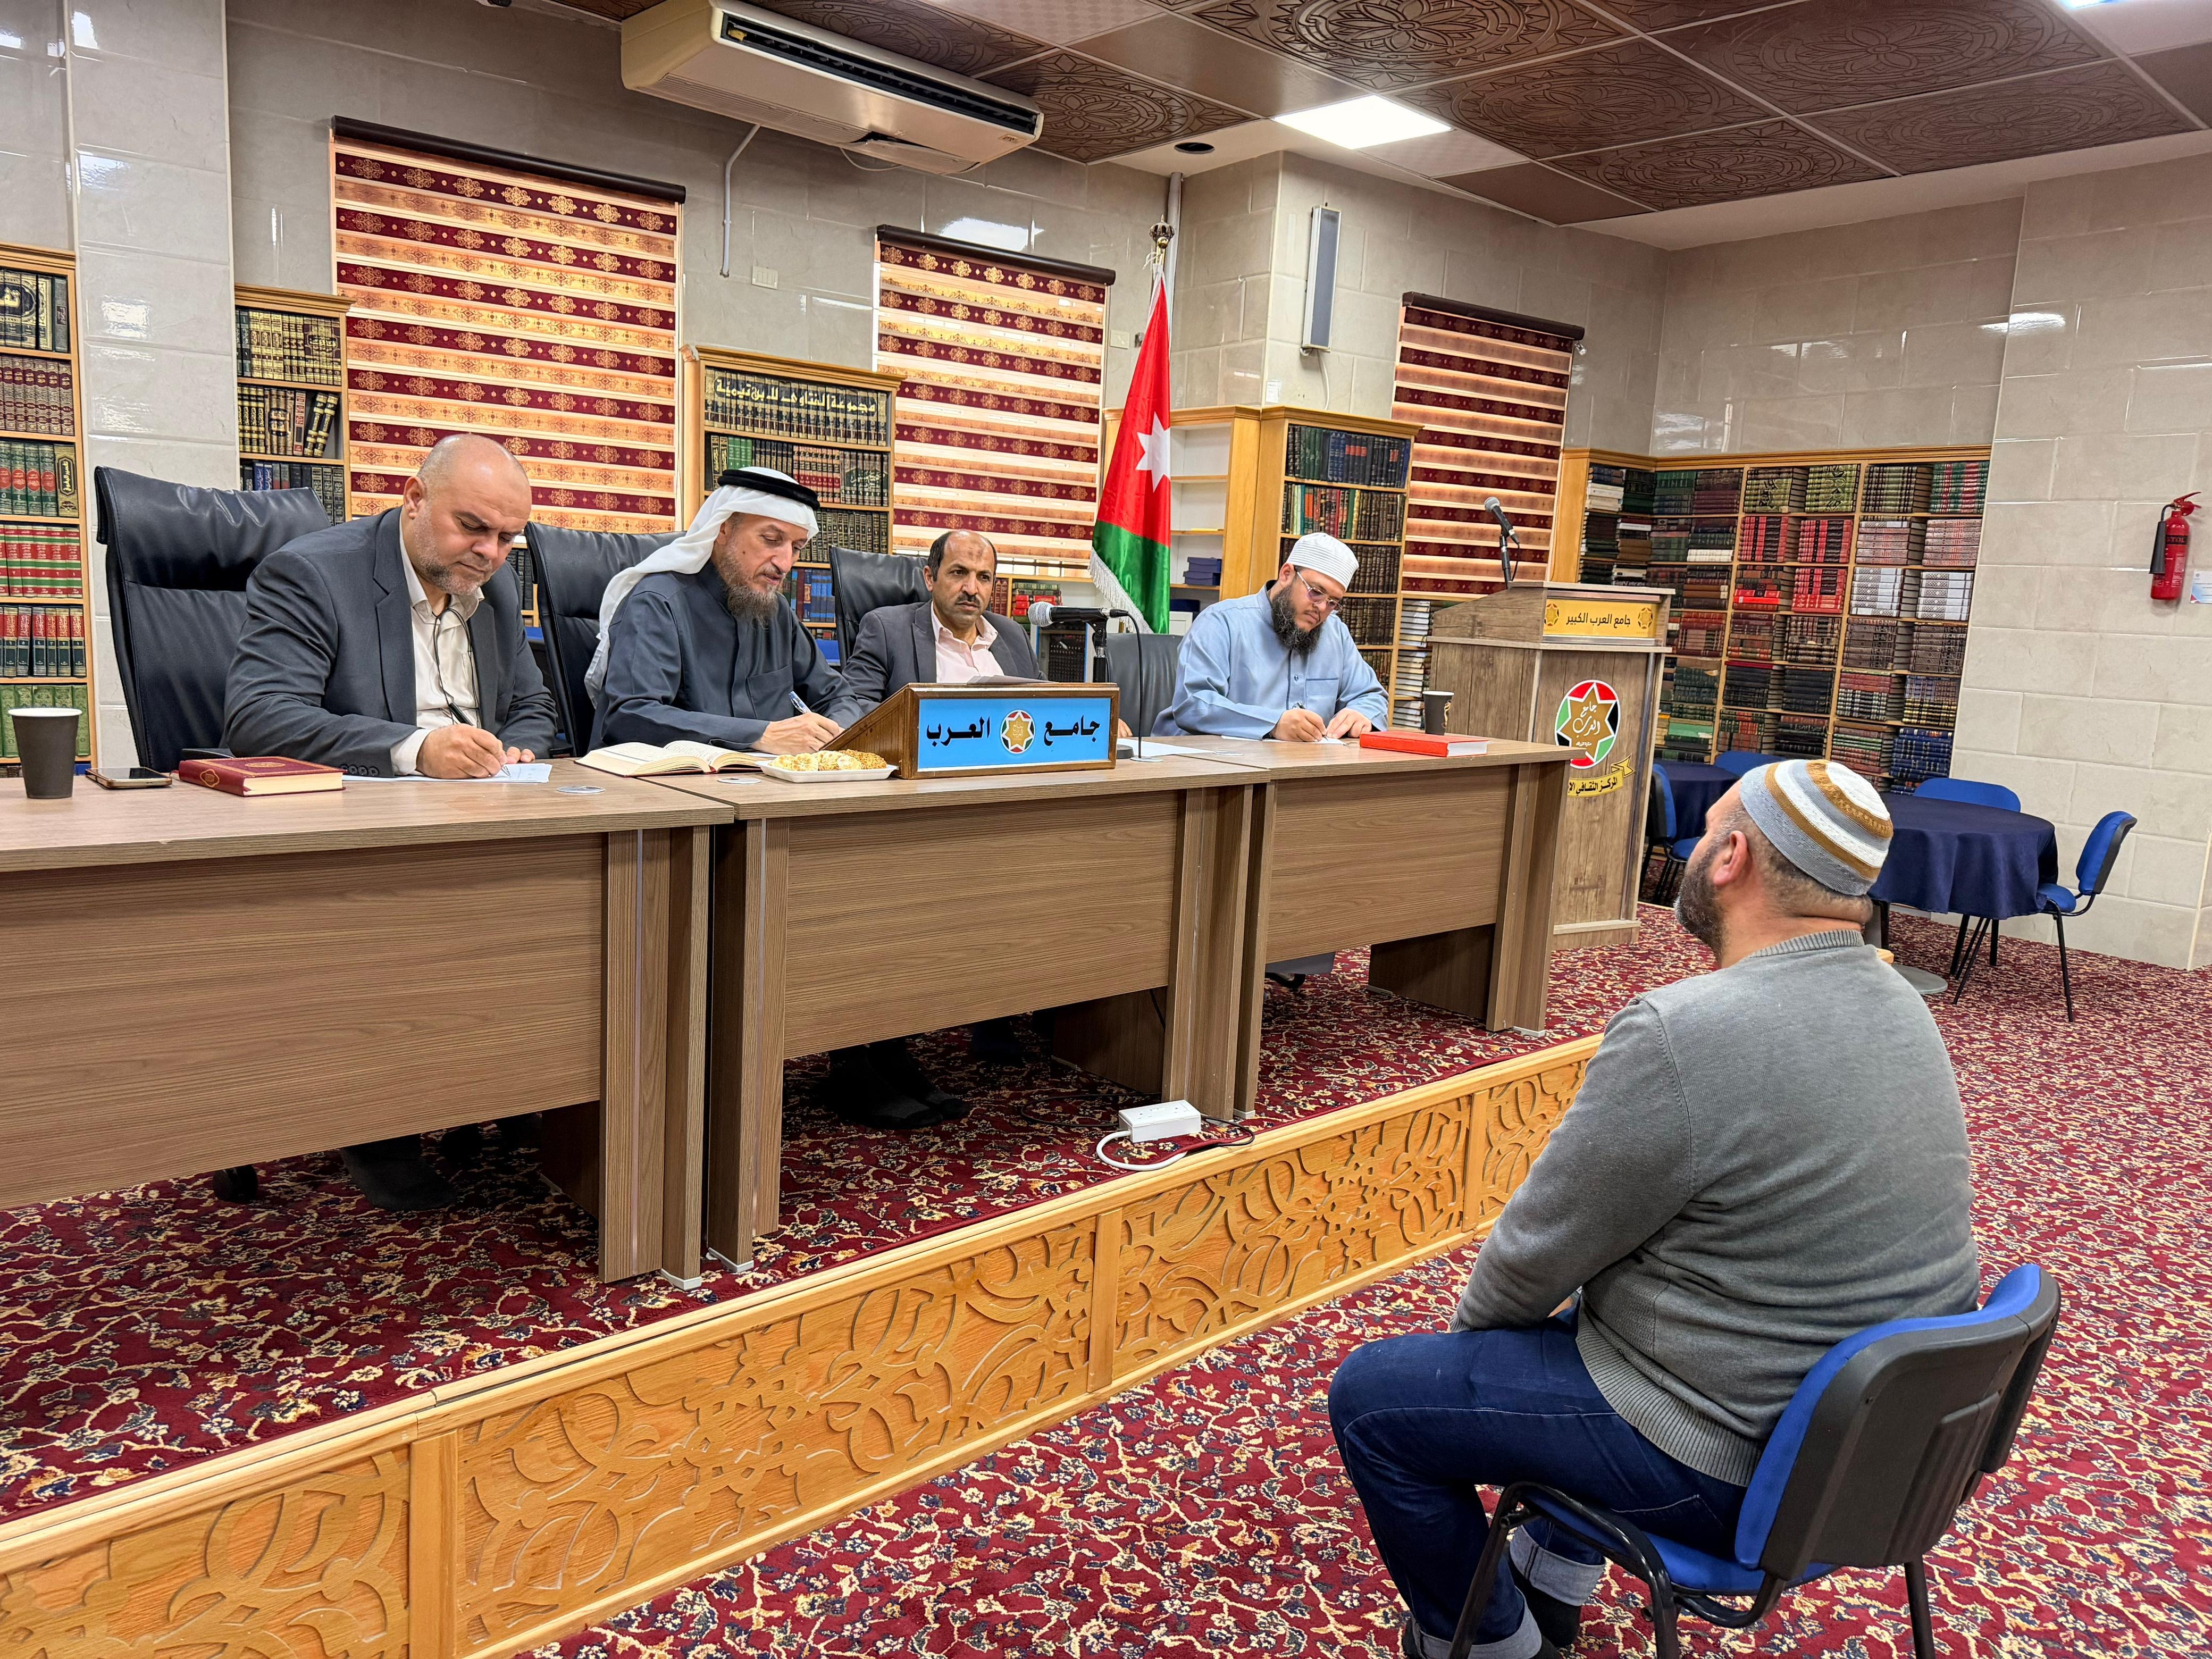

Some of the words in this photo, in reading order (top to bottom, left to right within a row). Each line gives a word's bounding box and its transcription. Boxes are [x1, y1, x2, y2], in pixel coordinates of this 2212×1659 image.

[1565, 612, 1588, 626] الكبير
[1589, 614, 1612, 626] العرب
[1613, 614, 1631, 629] جامع
[1580, 700, 1597, 718] جامع
[926, 716, 991, 747] العرب
[1044, 715, 1101, 746] جامع
[1572, 715, 1601, 738] العرب
[1576, 781, 1598, 796] الثقافي
[1599, 777, 1618, 792] المركز
